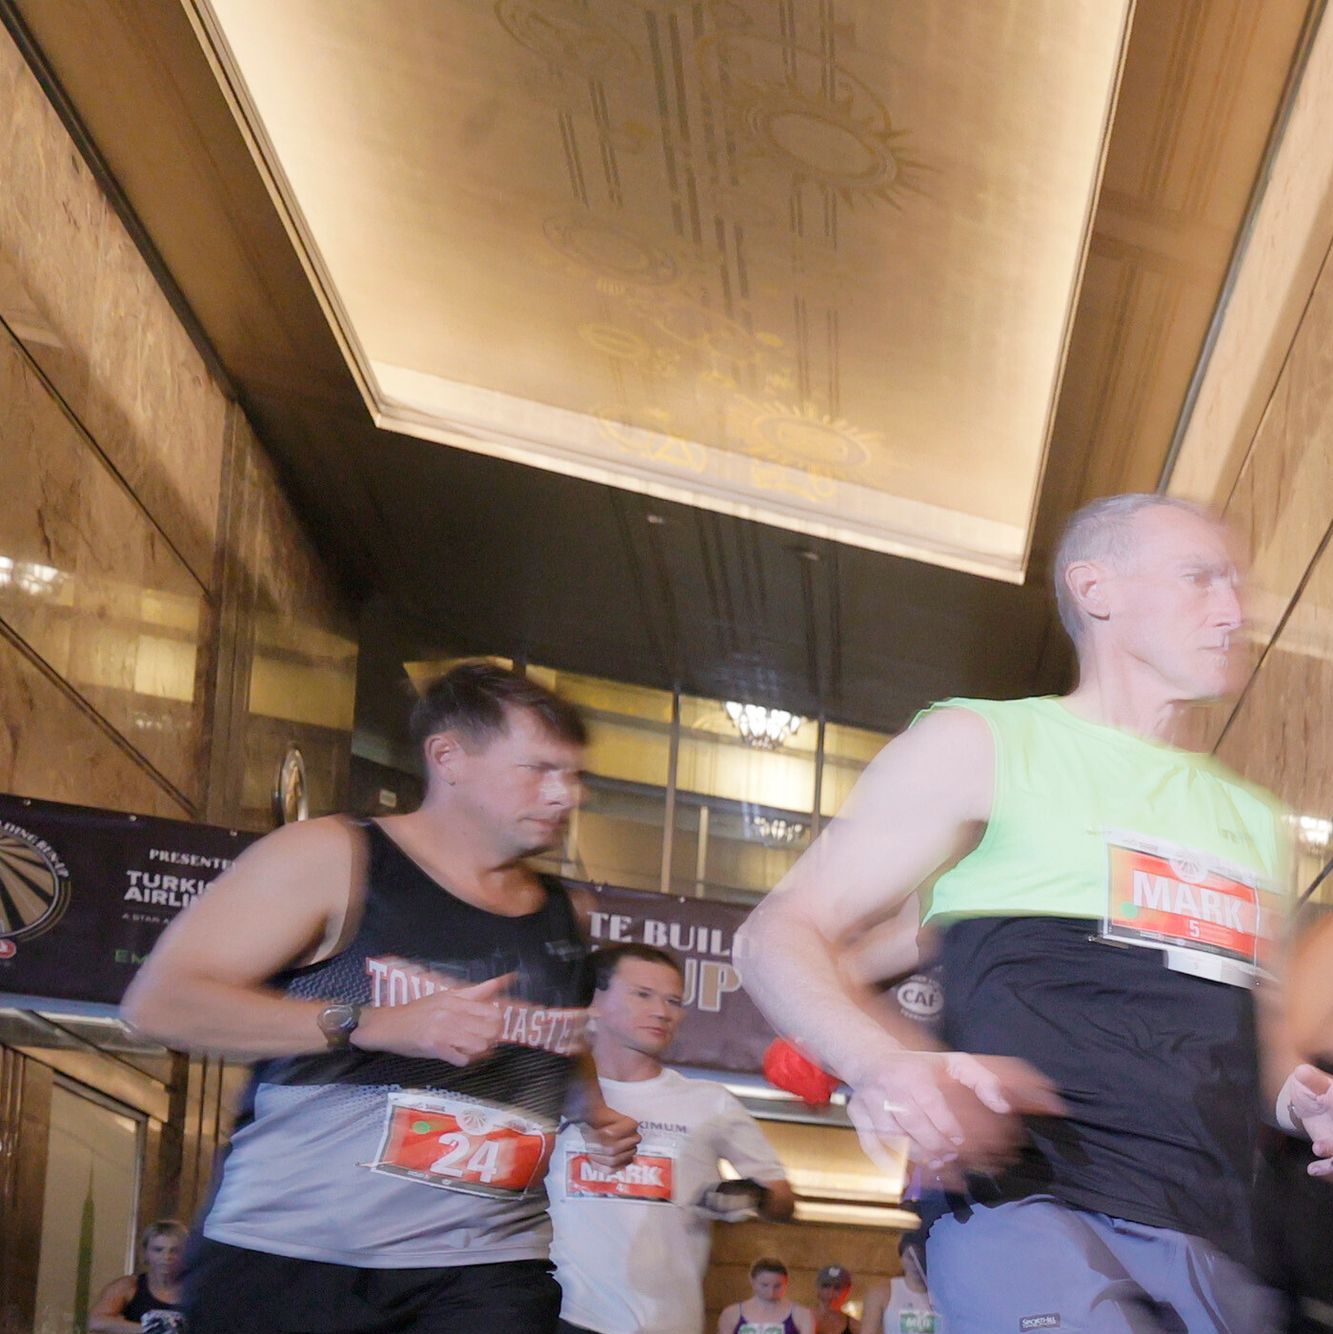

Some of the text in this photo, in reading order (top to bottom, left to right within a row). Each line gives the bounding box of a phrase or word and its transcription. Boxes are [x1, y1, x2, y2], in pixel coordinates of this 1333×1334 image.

[1132, 869, 1246, 934] MARK
[1188, 919, 1199, 937] 5
[638, 1120, 688, 1134] XIMUM
[430, 1132, 500, 1184] 24
